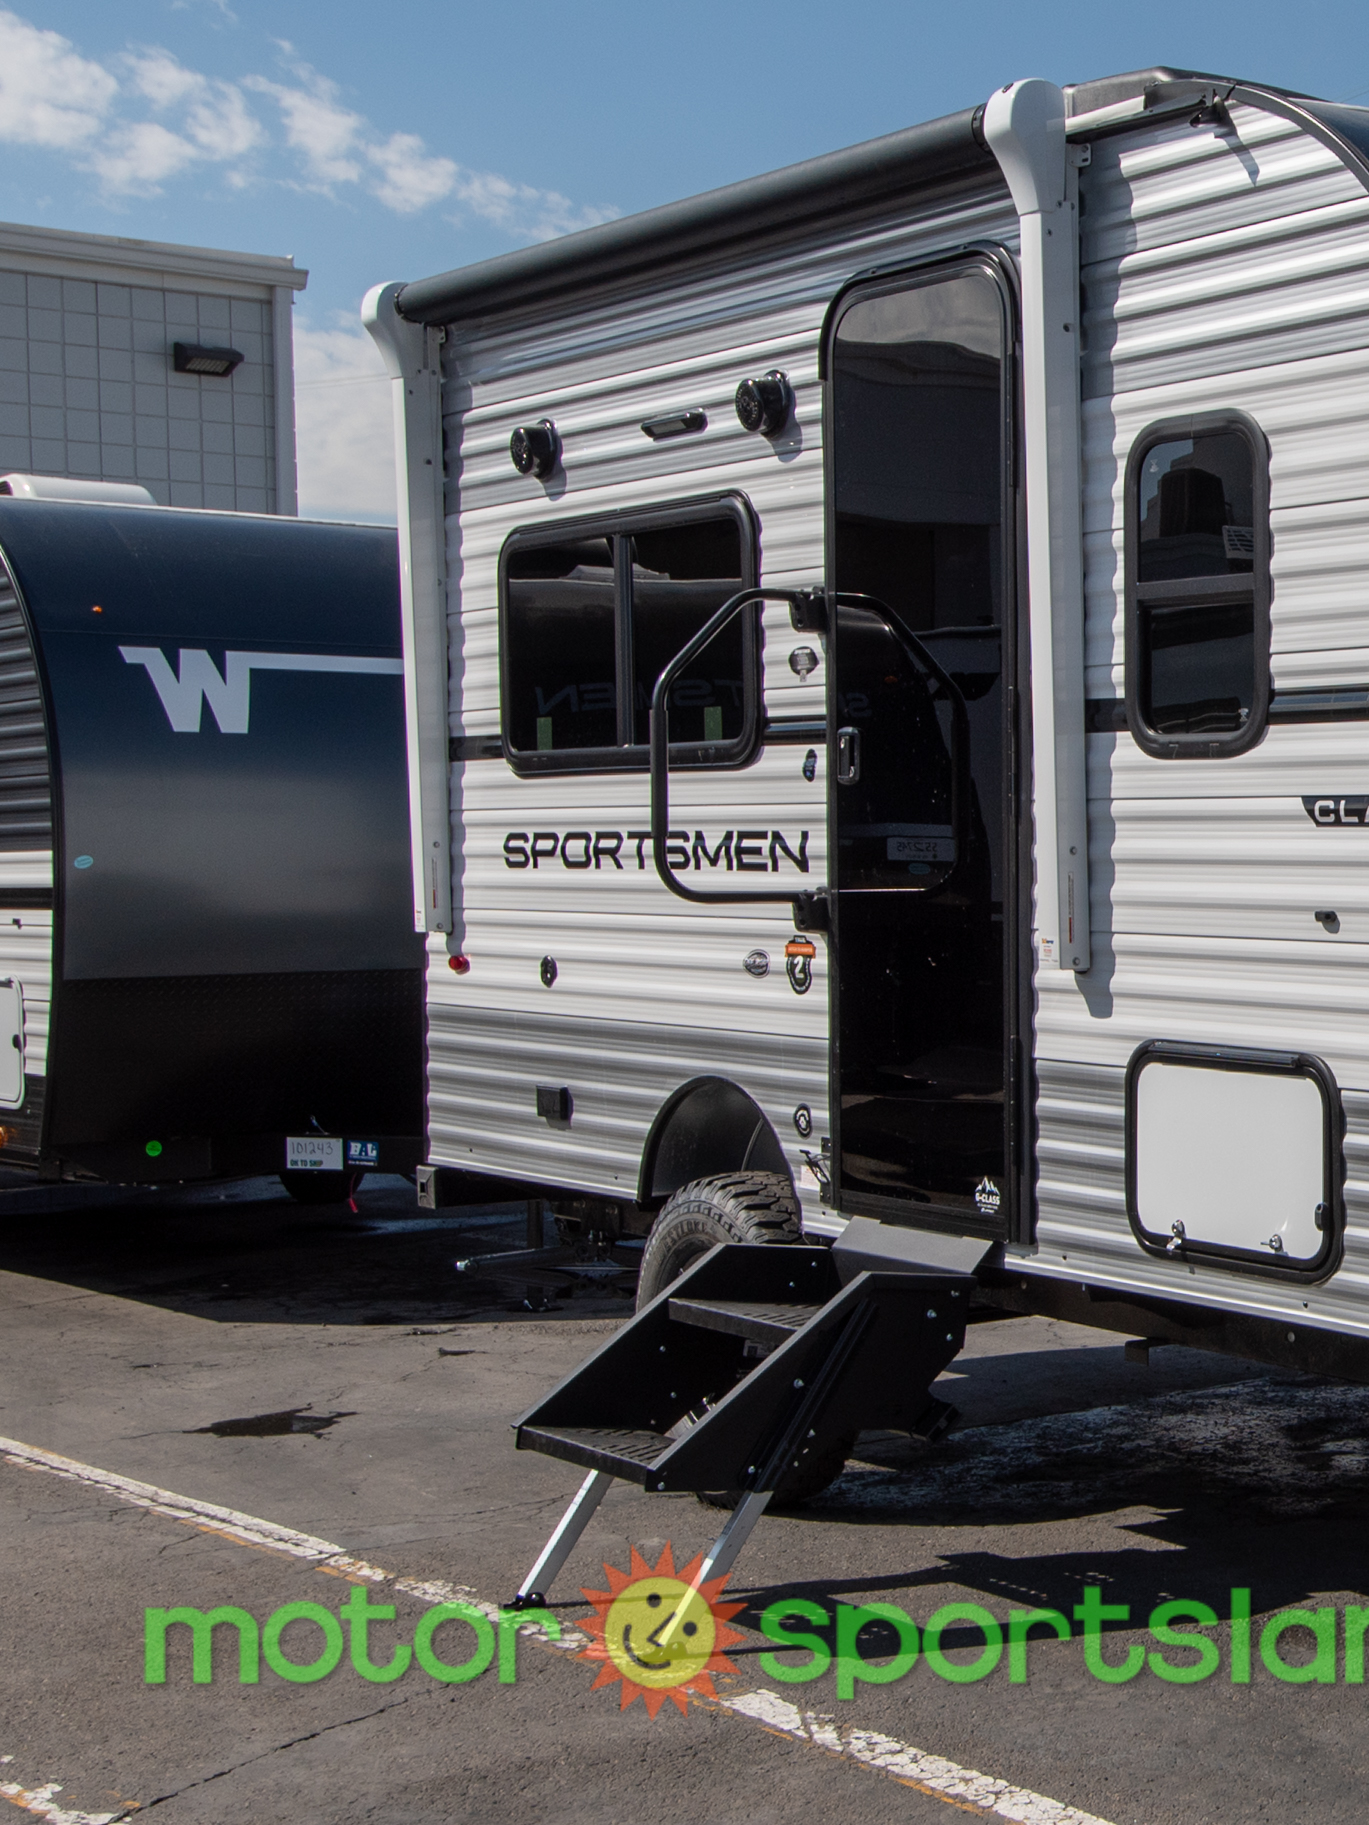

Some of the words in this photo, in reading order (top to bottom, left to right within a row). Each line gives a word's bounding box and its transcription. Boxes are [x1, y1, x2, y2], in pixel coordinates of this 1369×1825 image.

[503, 830, 810, 873] SPORTSMEN
[794, 955, 804, 978] 2
[291, 1141, 333, 1156] 101243
